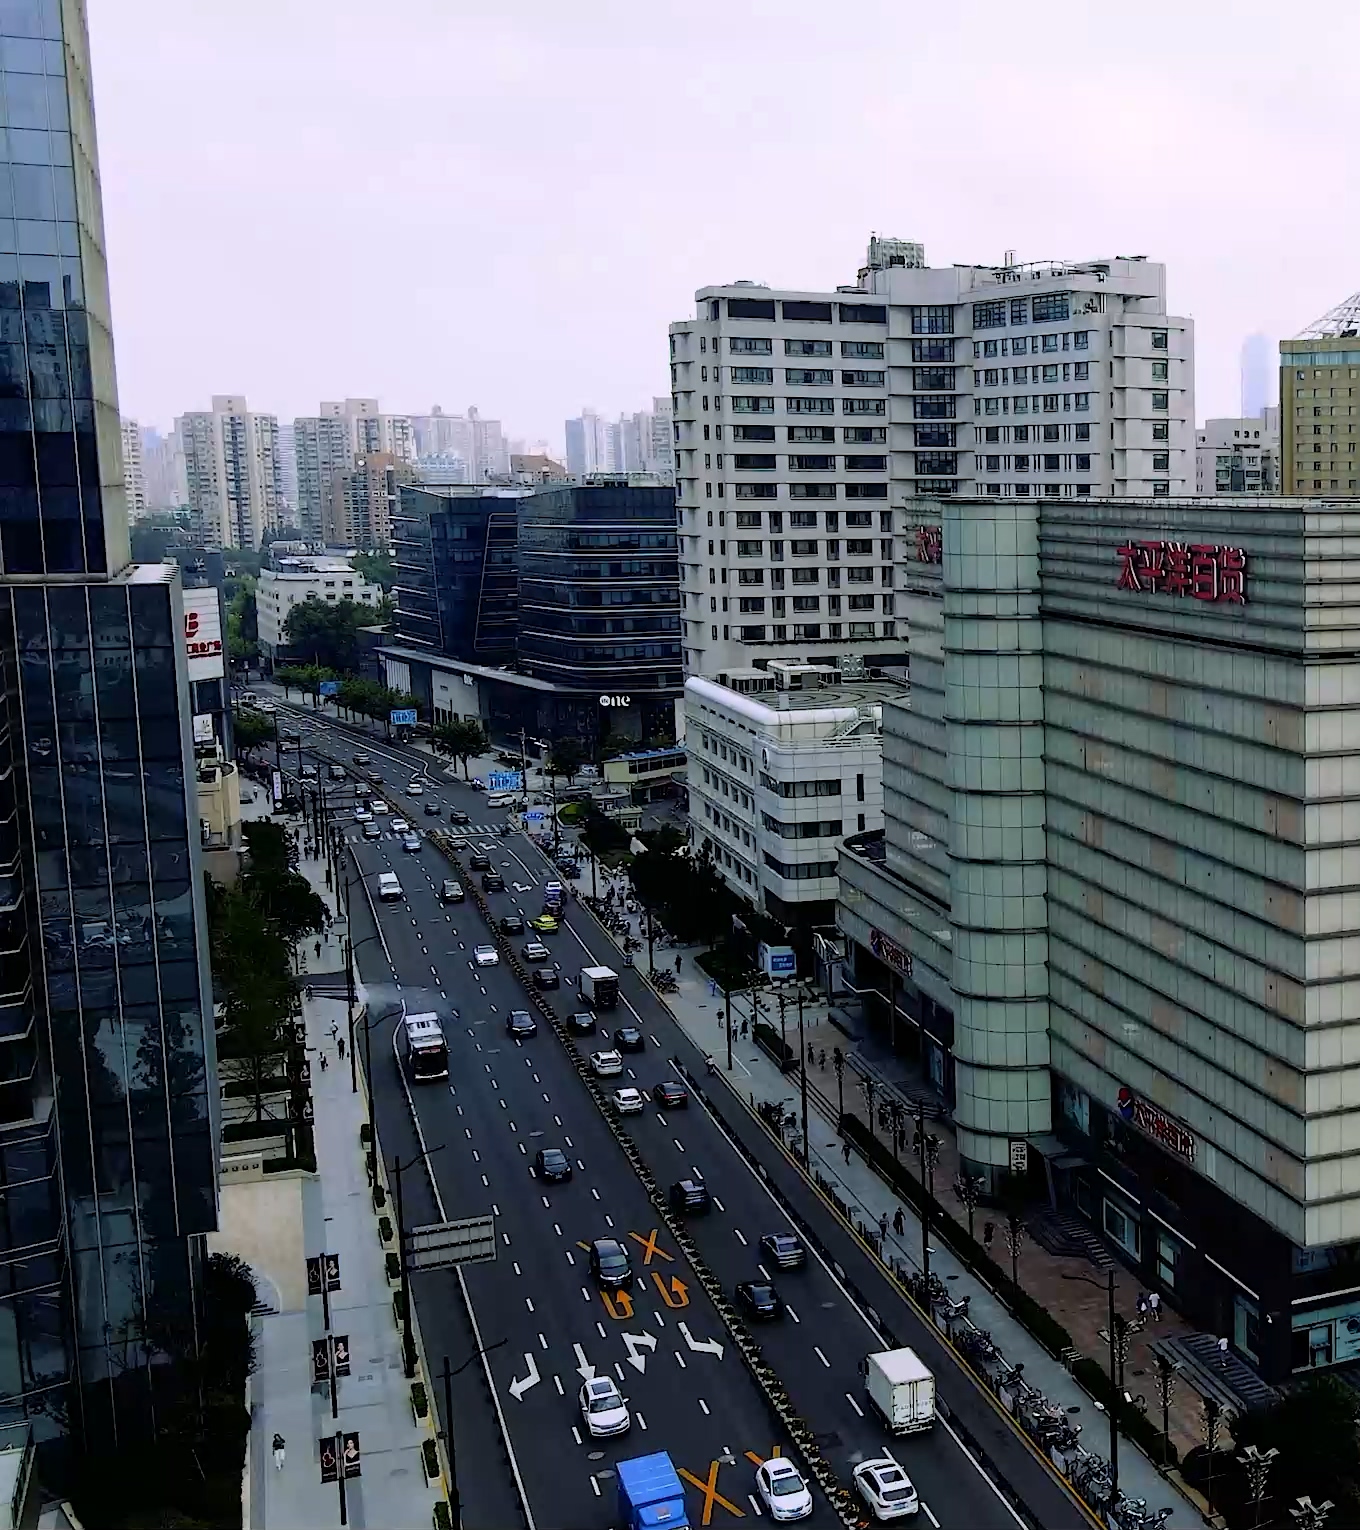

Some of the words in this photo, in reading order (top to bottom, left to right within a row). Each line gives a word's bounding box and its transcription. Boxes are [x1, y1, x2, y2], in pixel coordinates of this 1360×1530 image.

[1116, 539, 1249, 605] 太平洋百货
